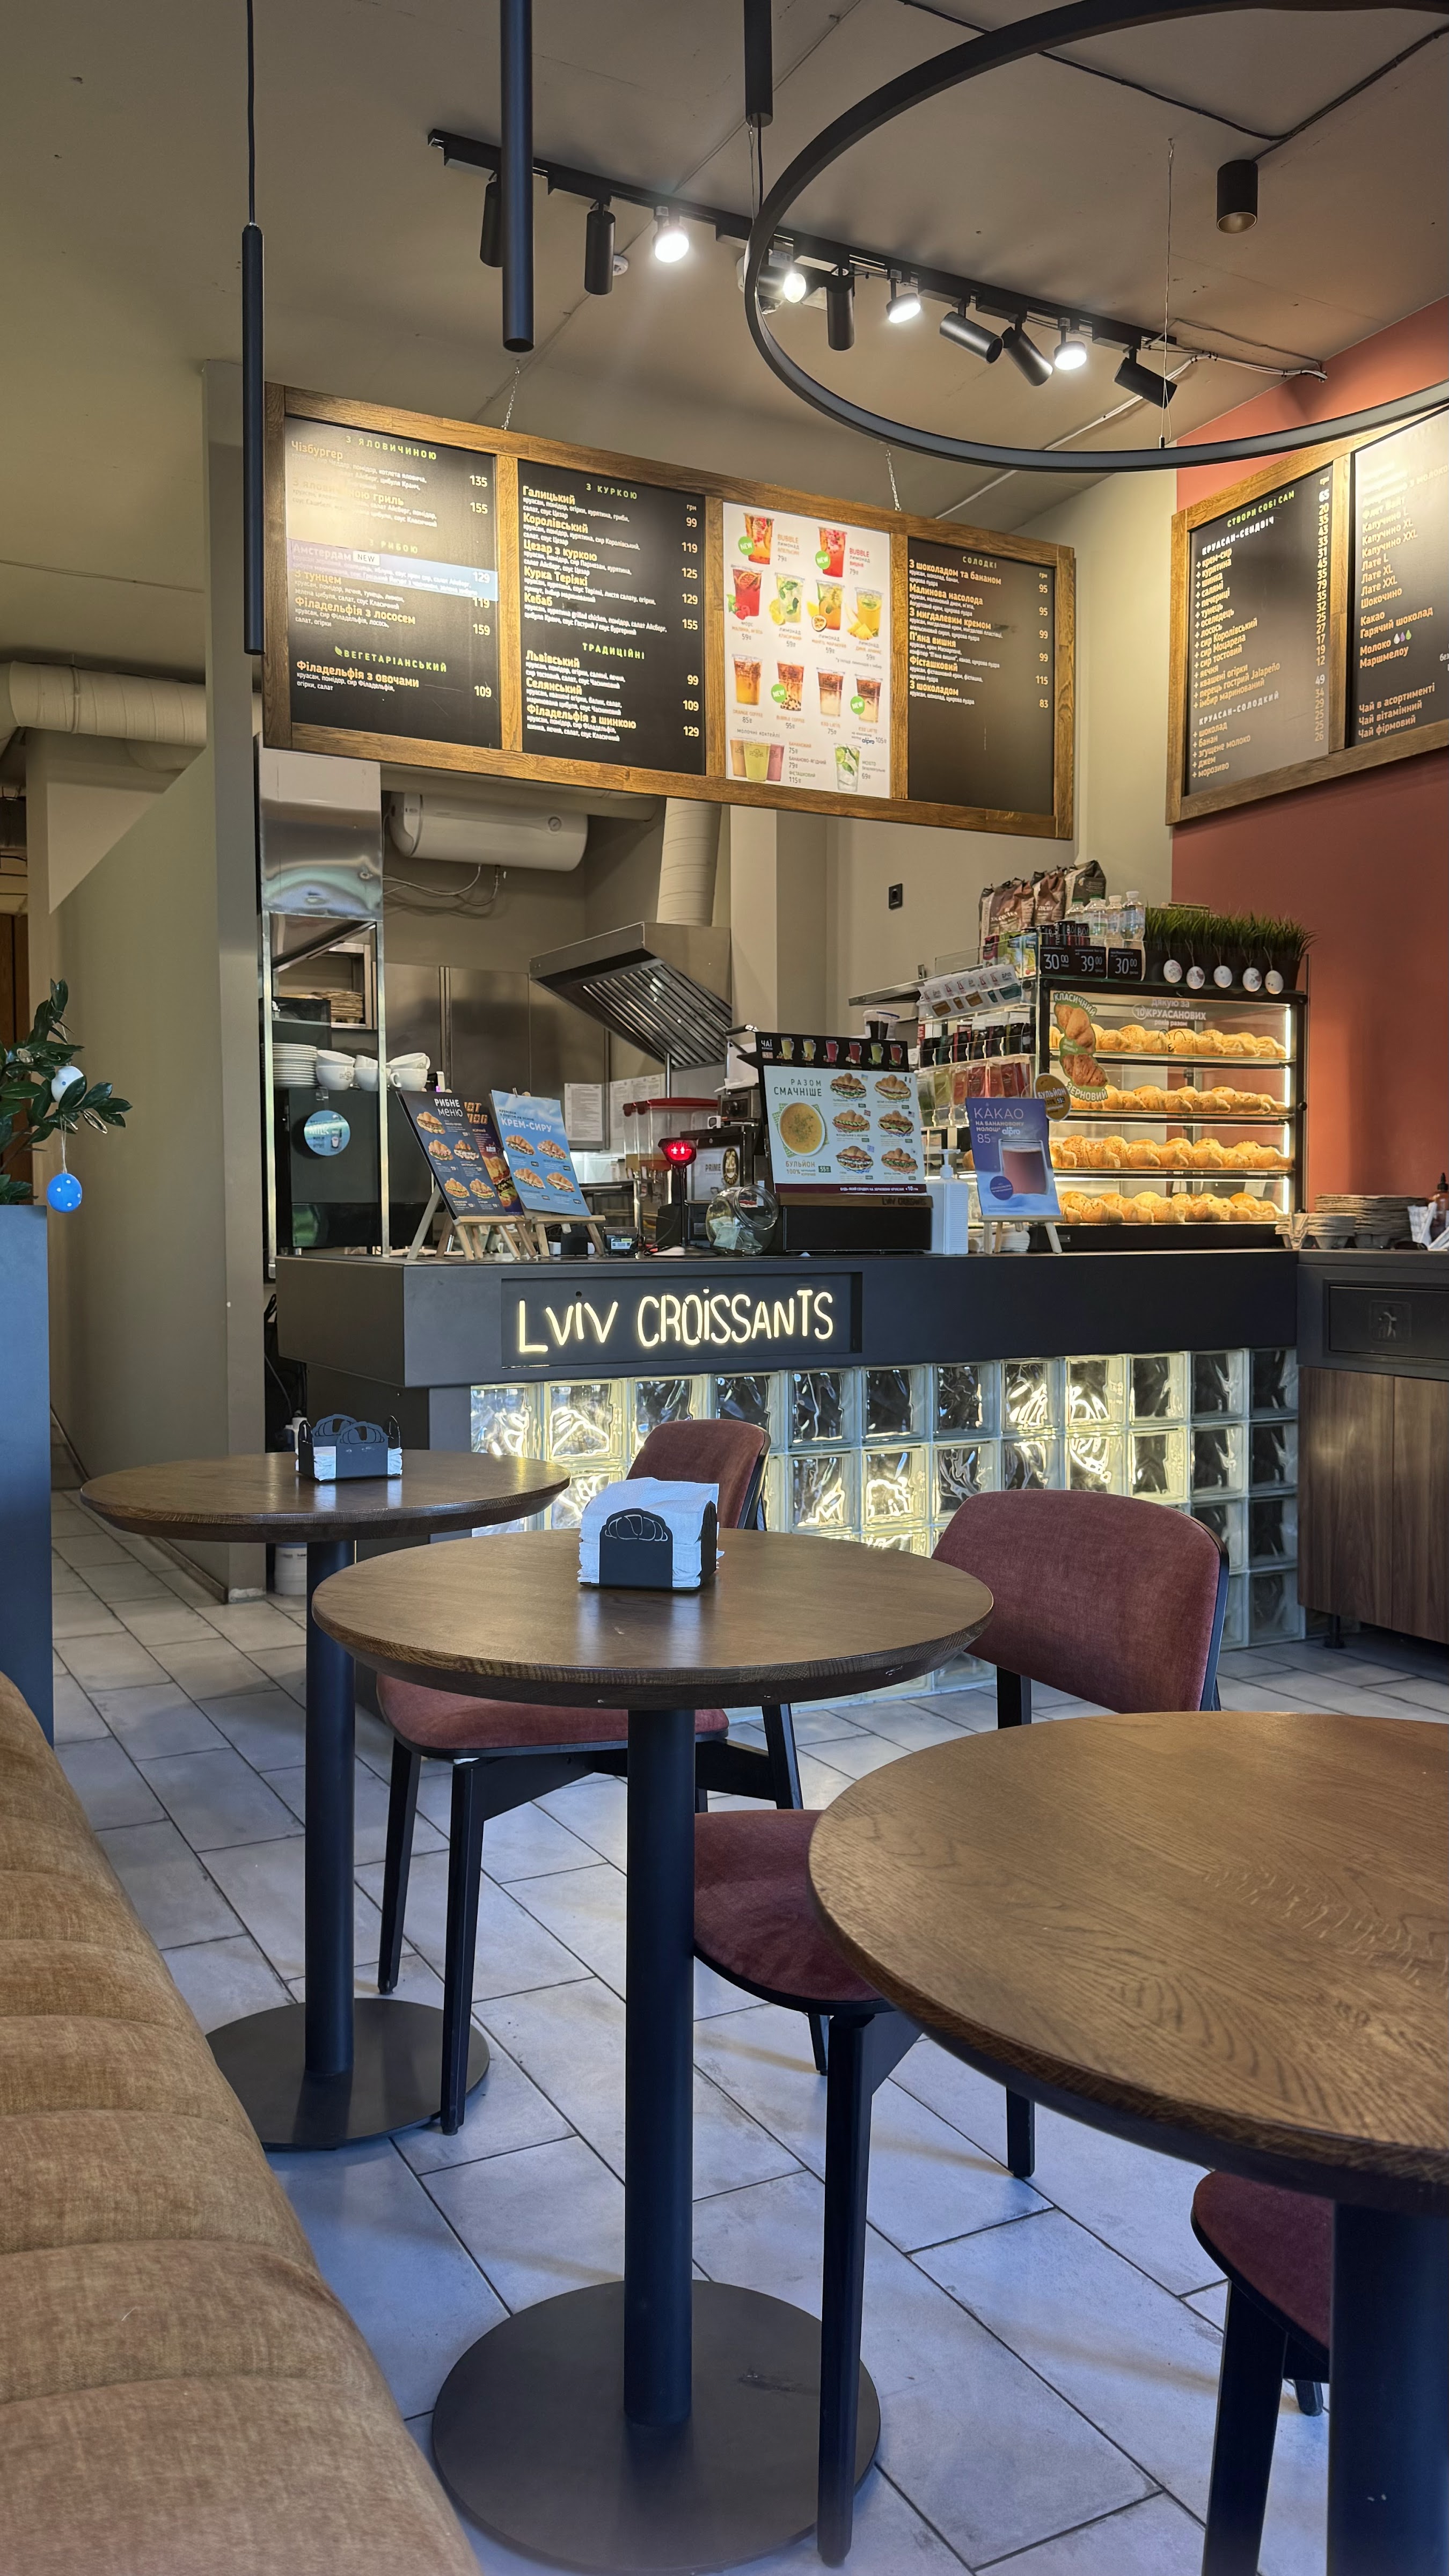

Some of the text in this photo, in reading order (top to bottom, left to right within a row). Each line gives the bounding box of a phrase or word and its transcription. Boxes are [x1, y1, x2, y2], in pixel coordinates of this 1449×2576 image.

[291, 441, 343, 461] Чізбургер
[358, 438, 436, 460] ЯЛОВИЧИНОЮ
[470, 475, 487, 487] 135
[373, 493, 404, 506] гриль
[523, 486, 575, 505] Галицький
[597, 485, 638, 500] КУРКОЮ
[470, 502, 488, 514] 155
[1227, 508, 1256, 528] СТВОРИ
[1258, 499, 1276, 513] СОБІ
[523, 513, 588, 534] Королівський
[686, 517, 697, 528] 99
[1362, 511, 1401, 533] Капучино
[777, 534, 799, 543] BUBBLE
[1202, 516, 1275, 555] КРУАСАН-СЕНДВІЧ
[1362, 524, 1401, 546] Капучино
[381, 540, 418, 554] РИБОЮ
[524, 539, 597, 562] Цезар куркою
[682, 542, 697, 553] 119
[740, 541, 752, 550] NEW
[1362, 529, 1418, 559] Капучино XXL
[293, 544, 352, 561] Амстердам
[357, 553, 375, 562] NEW
[817, 555, 828, 564] NEW
[850, 548, 869, 557] BUBBLE
[1202, 548, 1232, 568] крем-сир
[962, 556, 997, 568] СОЛОДКІ
[1202, 558, 1232, 579] курятина
[1362, 558, 1382, 571] Лате
[303, 570, 341, 585] тунцем
[473, 571, 490, 583] 129
[524, 566, 588, 587] Курка Теріякі
[682, 567, 698, 579] 125
[916, 562, 958, 577] шоколадом
[970, 572, 1001, 585] бананом
[1202, 573, 1223, 588] шинка
[1361, 564, 1393, 584] Лате XL
[909, 583, 983, 605] Малинова насолода
[1039, 584, 1048, 593] 95
[1201, 580, 1224, 597] салямі
[1361, 575, 1397, 597] Лате XXL
[473, 597, 490, 609] 119
[524, 592, 553, 606] Кебаб
[682, 593, 698, 605] 129
[1201, 587, 1230, 608] печериці
[1360, 587, 1402, 609] Шокочино
[295, 596, 416, 625] Філадельфія лососем
[1039, 607, 1048, 616] 95
[1201, 603, 1224, 618] тунець
[1201, 609, 1234, 628] оселедець
[1360, 611, 1385, 626] Какао
[682, 619, 698, 630] 155
[917, 611, 991, 630] мигдалевим кремом
[1360, 607, 1433, 639] Гарячий шоколад
[473, 624, 490, 636] 159
[1039, 630, 1048, 639] 99
[1201, 624, 1223, 638] лосось
[1213, 618, 1257, 642] Королівський
[910, 631, 956, 648] П'яна вишня
[1213, 634, 1246, 652] Моцарела
[1360, 639, 1391, 656] Молоко
[526, 650, 580, 668] Львівський
[582, 642, 645, 660] ТРАДИЦІЙНІ
[1039, 653, 1048, 662] 99
[1213, 645, 1242, 663] тостовий
[1360, 646, 1409, 669] Маршмелоу
[344, 649, 447, 672] ВЕГЕТАРІАНСЬКИЙ
[910, 656, 958, 672] Фісташковий
[296, 661, 419, 687] Філадельфія овочами
[1200, 665, 1219, 678] яєчня
[1200, 664, 1248, 688] квашені огірки
[1315, 674, 1325, 685] 49
[526, 677, 582, 696] Селянський
[687, 674, 699, 686] 99
[910, 680, 958, 696] З шоколадом
[1036, 675, 1048, 685] 115
[1199, 663, 1280, 699] перець гострий Jalapeño
[474, 685, 492, 698] 109
[772, 689, 785, 697] NEW
[1199, 677, 1264, 708] імбир маринований
[1359, 682, 1435, 714] Чай асортименті
[683, 699, 699, 711] 109
[852, 701, 863, 709] NEW
[1039, 699, 1048, 708] 83
[1199, 691, 1279, 726] КРУАСАН-СОЛОДКИЙ
[526, 704, 589, 723] Філадельфія
[599, 716, 636, 729] шинкою
[1359, 700, 1422, 726] Чай вітамінний
[684, 726, 699, 737] 129
[1198, 722, 1227, 738] шоколад
[1358, 714, 1416, 738] Чай фірмовий
[1198, 736, 1218, 748] банан
[1198, 735, 1251, 758] згущене молоко
[1198, 756, 1216, 769] джем
[1198, 762, 1229, 778] морозиво
[1044, 954, 1069, 970] 30 00
[1081, 955, 1102, 972] 39 00
[1115, 958, 1137, 975] 30 00
[1054, 993, 1096, 1016] КЛАСИЧНИЙ
[1146, 1008, 1206, 1020] КРУАСАНОВИХ
[774, 1087, 822, 1096] СМАЧНІШЕ
[1038, 1087, 1066, 1098] БУЛЬЙОН
[1066, 1082, 1108, 1100] ЗЕРНОВИЙ
[434, 1099, 460, 1107] РИБНЕ
[974, 1108, 1023, 1119] КАКАО
[501, 1118, 552, 1132] КРЕМ-СИРУ
[1002, 1127, 1020, 1137] alpro
[977, 1134, 991, 1143] 85
